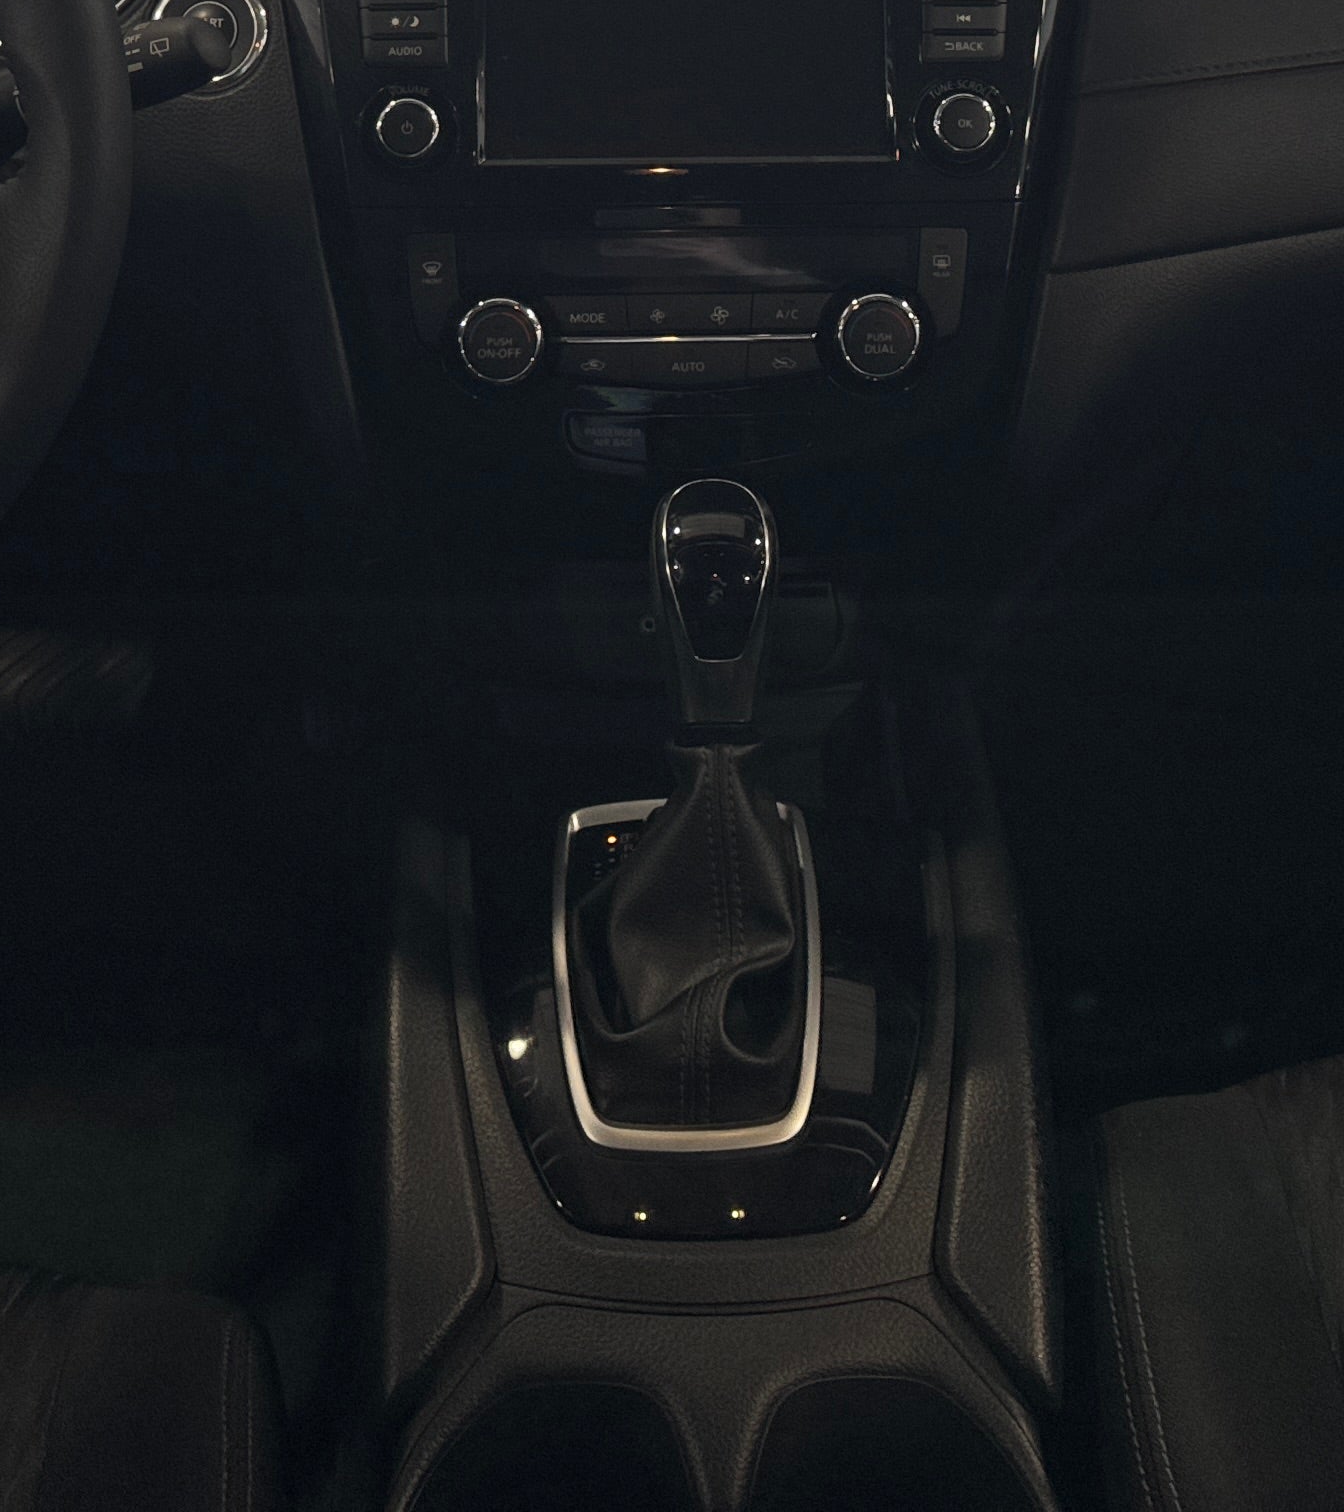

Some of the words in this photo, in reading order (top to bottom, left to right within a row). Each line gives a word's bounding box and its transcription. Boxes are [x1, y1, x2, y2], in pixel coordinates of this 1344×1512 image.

[123, 33, 142, 46] OFF
[388, 47, 422, 56] AUDIO
[956, 42, 984, 51] BACK
[957, 119, 973, 128] OK
[569, 313, 606, 324] MODE
[775, 308, 799, 320] A/C
[477, 348, 522, 359] ON-OFF
[864, 344, 896, 354] DUAL
[672, 361, 705, 372] AUTO
